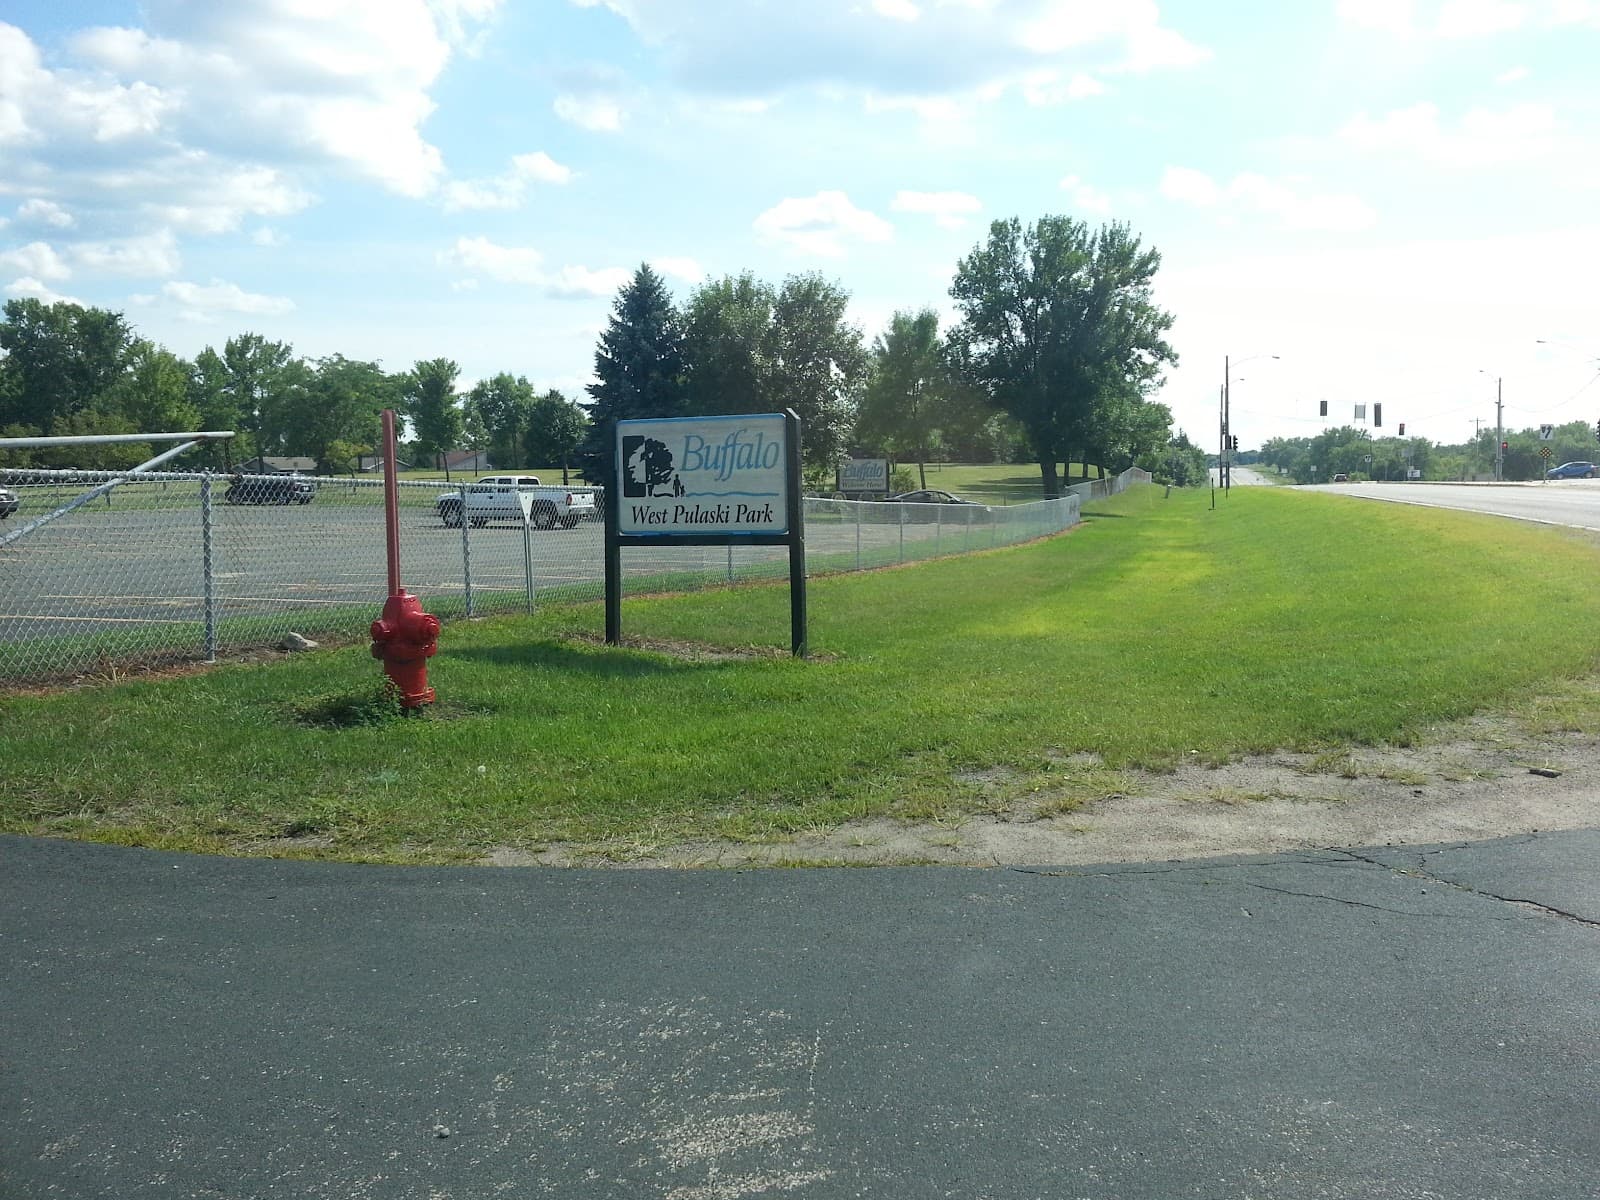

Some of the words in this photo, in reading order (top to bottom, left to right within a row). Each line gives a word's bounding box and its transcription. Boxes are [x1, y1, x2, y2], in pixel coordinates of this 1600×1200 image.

[681, 429, 780, 481] Buffalo
[632, 505, 668, 524] West
[672, 503, 731, 524] Pulaski
[735, 503, 773, 523] Park
